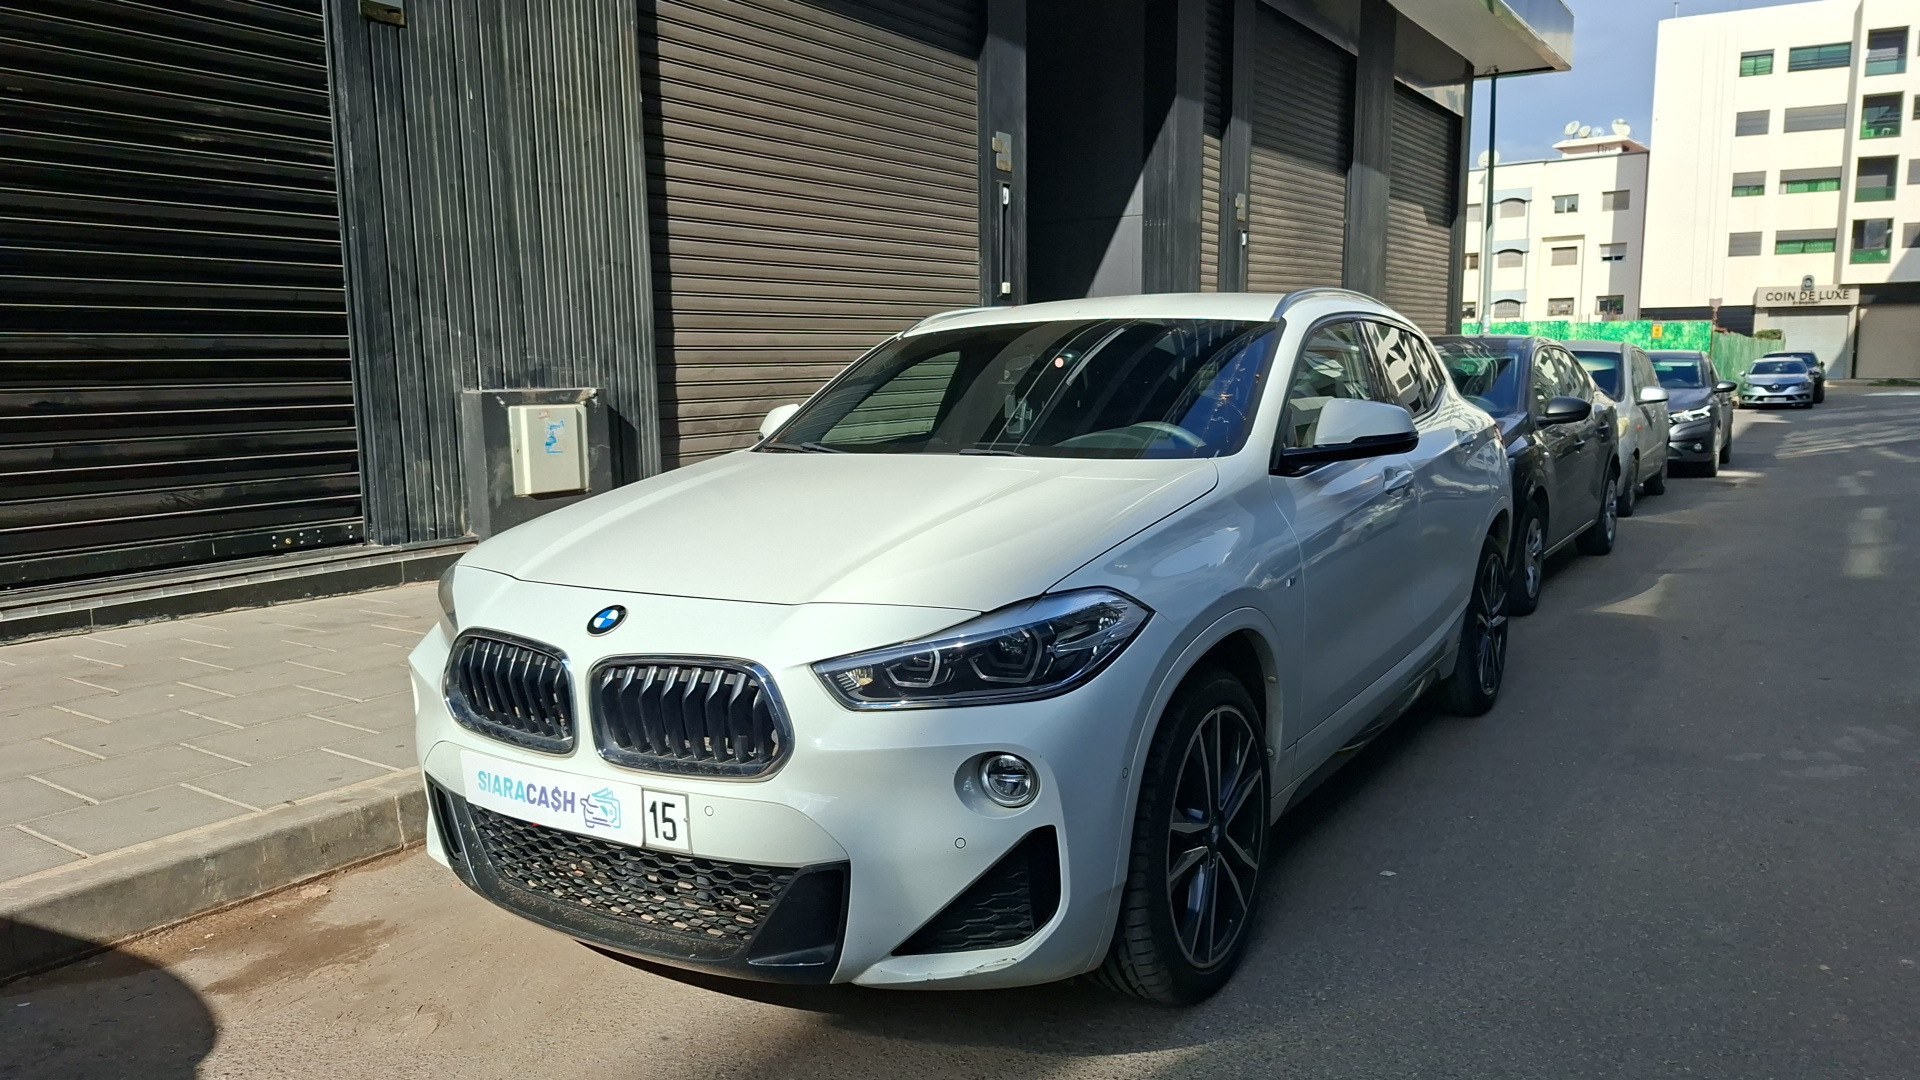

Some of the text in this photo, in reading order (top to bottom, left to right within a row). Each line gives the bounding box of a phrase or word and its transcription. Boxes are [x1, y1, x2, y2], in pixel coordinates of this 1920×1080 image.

[1765, 290, 1850, 301] COIN DE LUXE
[649, 801, 678, 841] 15
